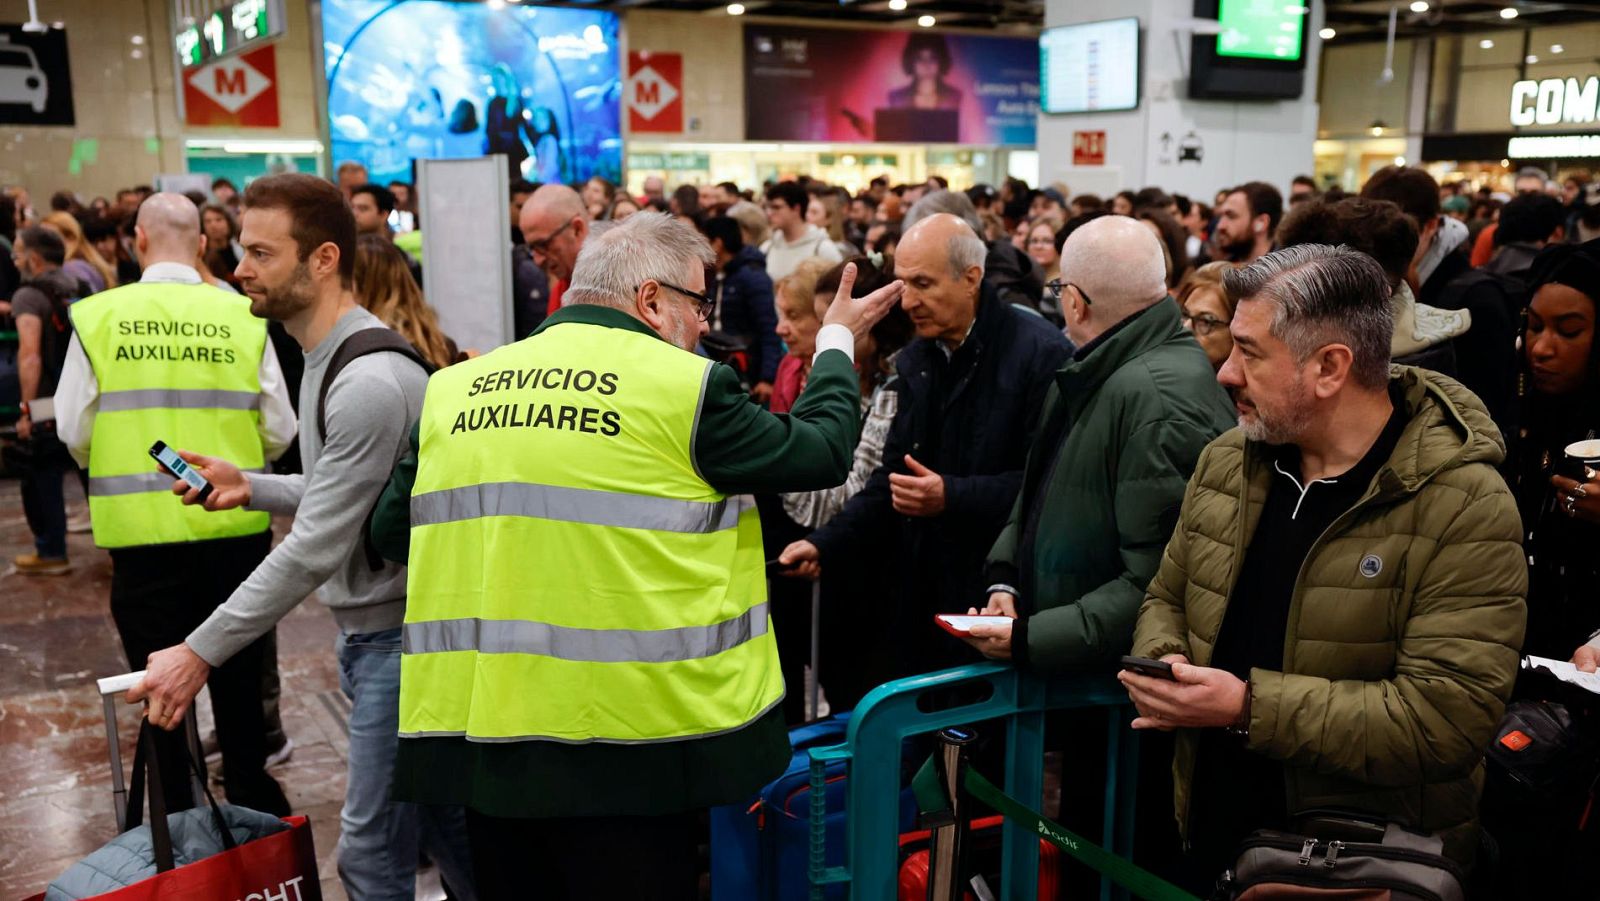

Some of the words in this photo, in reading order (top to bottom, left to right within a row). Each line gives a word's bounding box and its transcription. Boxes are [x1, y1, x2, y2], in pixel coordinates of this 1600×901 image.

[214, 68, 246, 96] M
[635, 80, 659, 104] M
[1510, 75, 1600, 127] COM
[119, 320, 231, 339] SERVICIOS
[115, 345, 235, 363] AUXILIARES
[468, 368, 619, 397] SERVICIOS
[450, 403, 621, 436] AUXILIARES
